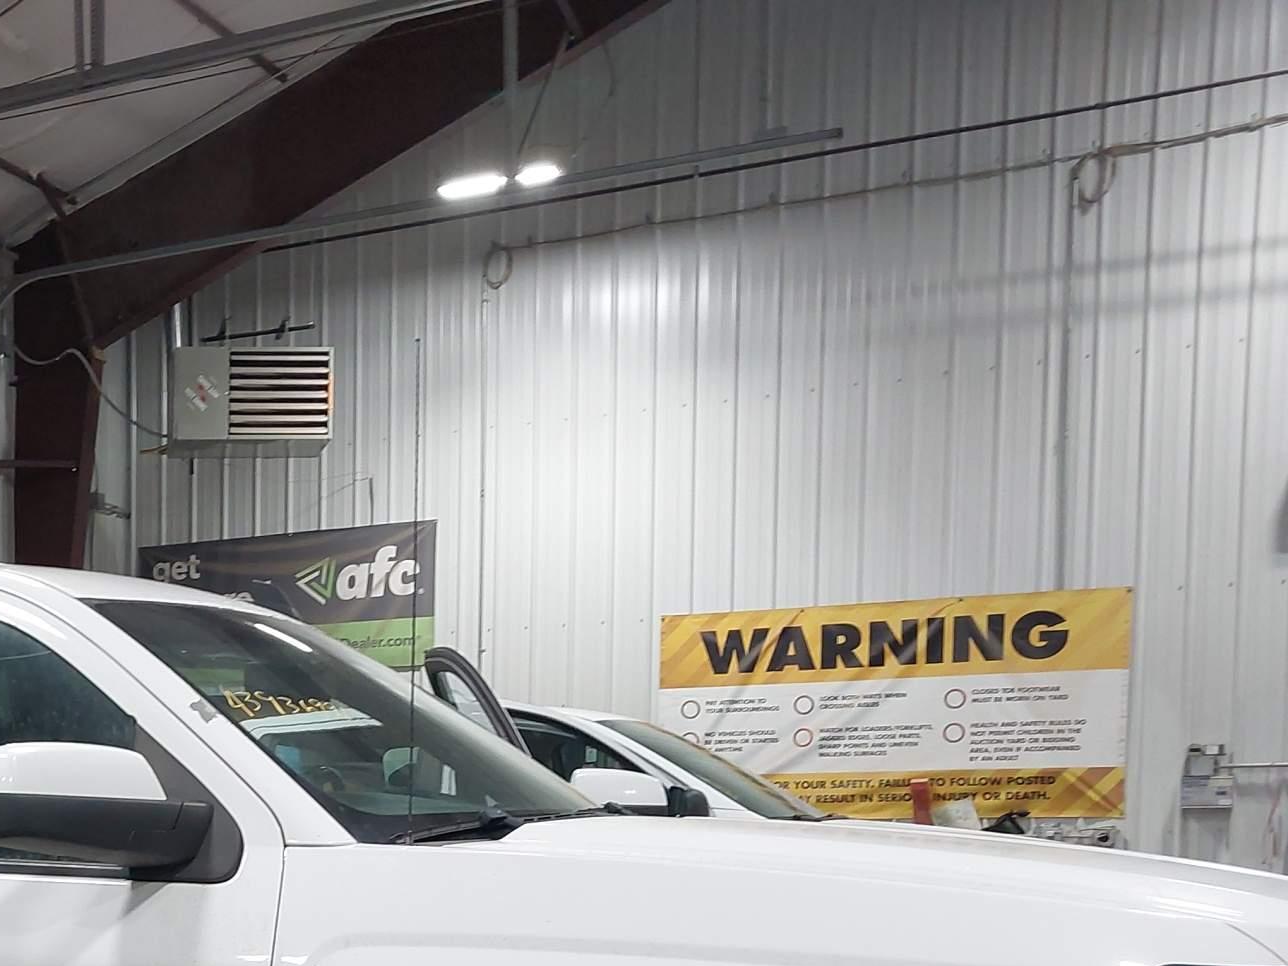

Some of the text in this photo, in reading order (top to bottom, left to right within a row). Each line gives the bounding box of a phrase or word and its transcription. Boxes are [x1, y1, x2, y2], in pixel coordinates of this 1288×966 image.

[153, 555, 200, 582] get
[339, 636, 415, 649] Dealer.com
[700, 610, 1070, 676] WARNING
[774, 781, 790, 790] OR
[794, 780, 826, 789] YOUR
[879, 777, 912, 788] FAILU
[930, 777, 946, 787] TO
[950, 776, 1002, 787] FOLLOW
[1007, 775, 1056, 786] POSTED
[816, 793, 860, 804] RESULT
[862, 793, 873, 803] IN
[878, 792, 913, 803] SERIO
[932, 791, 978, 801] INJURY
[983, 790, 1000, 801] OR
[1006, 790, 1051, 800] DEATH.
